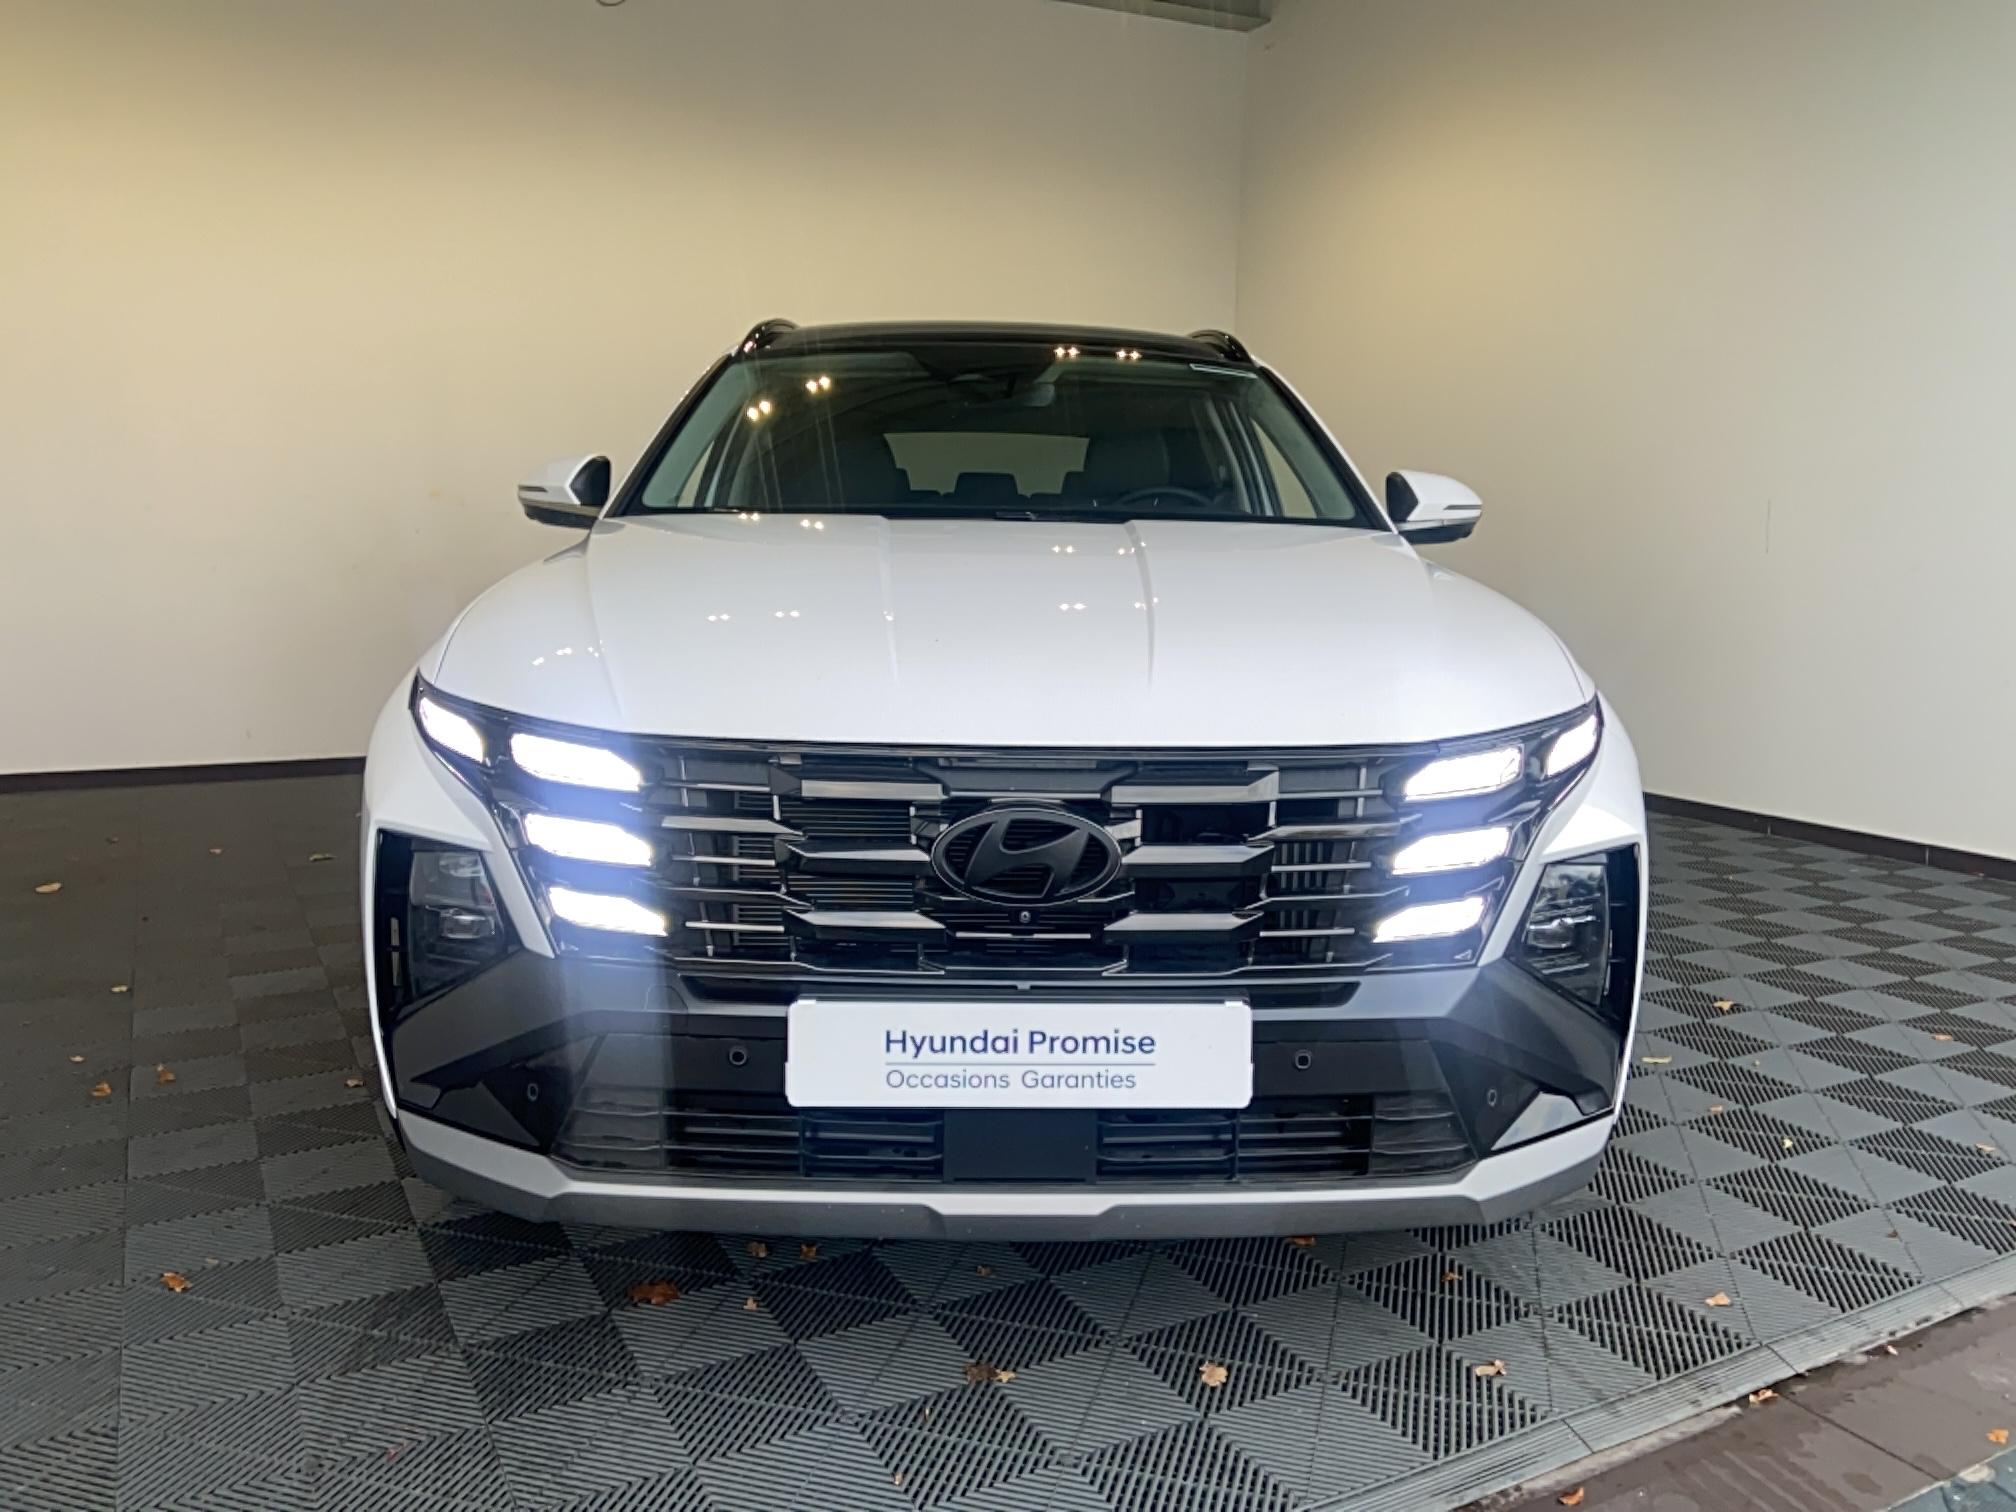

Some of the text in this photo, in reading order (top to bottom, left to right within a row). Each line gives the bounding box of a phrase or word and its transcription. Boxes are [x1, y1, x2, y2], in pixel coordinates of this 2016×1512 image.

[884, 1028, 1156, 1059] Hyundai Promise
[885, 1069, 1137, 1089] Occasions Garanties
